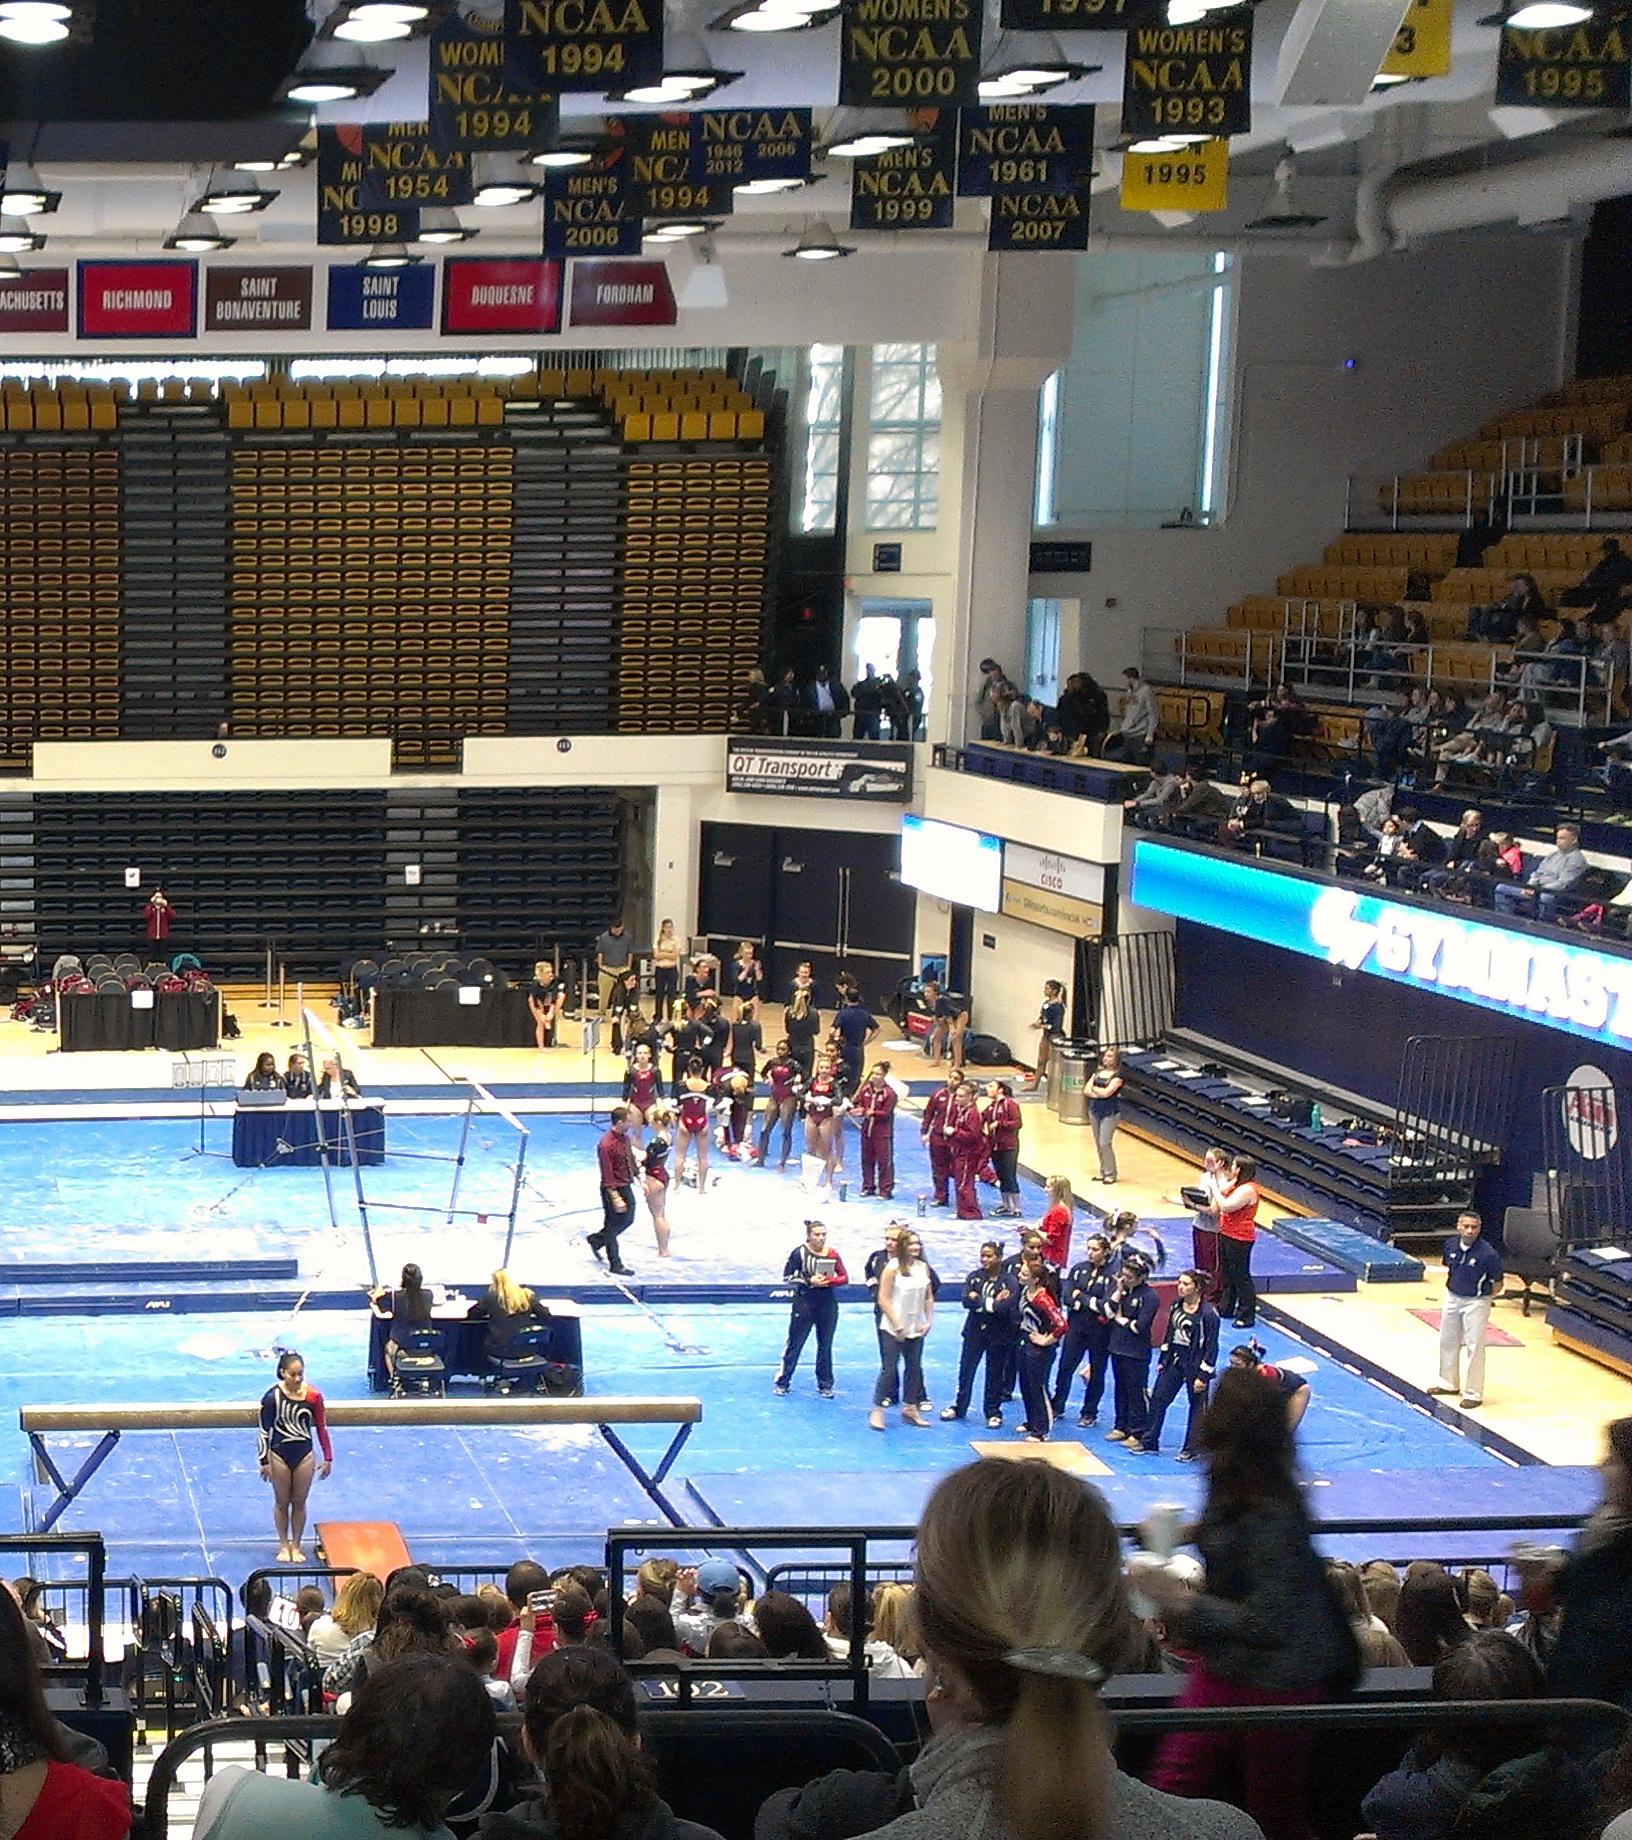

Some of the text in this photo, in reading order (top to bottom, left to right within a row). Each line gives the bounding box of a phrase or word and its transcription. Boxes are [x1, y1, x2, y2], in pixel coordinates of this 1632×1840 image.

[517, 0, 650, 35] NCAA
[849, 26, 973, 60] NCAA
[1137, 28, 1246, 53] WOMEN'S
[543, 43, 626, 75] 1994
[872, 66, 956, 96] 2000
[1130, 59, 1244, 91] NCAA
[1151, 97, 1226, 124] 1993
[457, 111, 532, 138] 1994
[701, 111, 802, 141] NCAA
[969, 126, 1066, 155] NCAA
[368, 142, 465, 169] NCAA
[877, 147, 934, 168] MEN'S
[857, 169, 950, 196] NCAA
[988, 160, 1049, 182] 1961
[1143, 163, 1207, 186] 1995
[385, 175, 450, 200] 1954
[568, 176, 618, 195] MEN'S
[647, 186, 711, 209] 1994
[999, 194, 1082, 217] NCAA
[875, 199, 934, 221] 1999
[339, 212, 398, 236] 1998
[1011, 220, 1067, 241] 2007
[241, 277, 277, 298] SAINT
[363, 275, 399, 297] SAINT
[472, 285, 534, 306] DUQUESNE
[596, 284, 654, 305] FORDHAM
[102, 290, 172, 310] RICHMOND
[216, 300, 300, 320] BONAVENTURE
[363, 299, 397, 319] LOUIS
[733, 755, 833, 783] QT Transport
